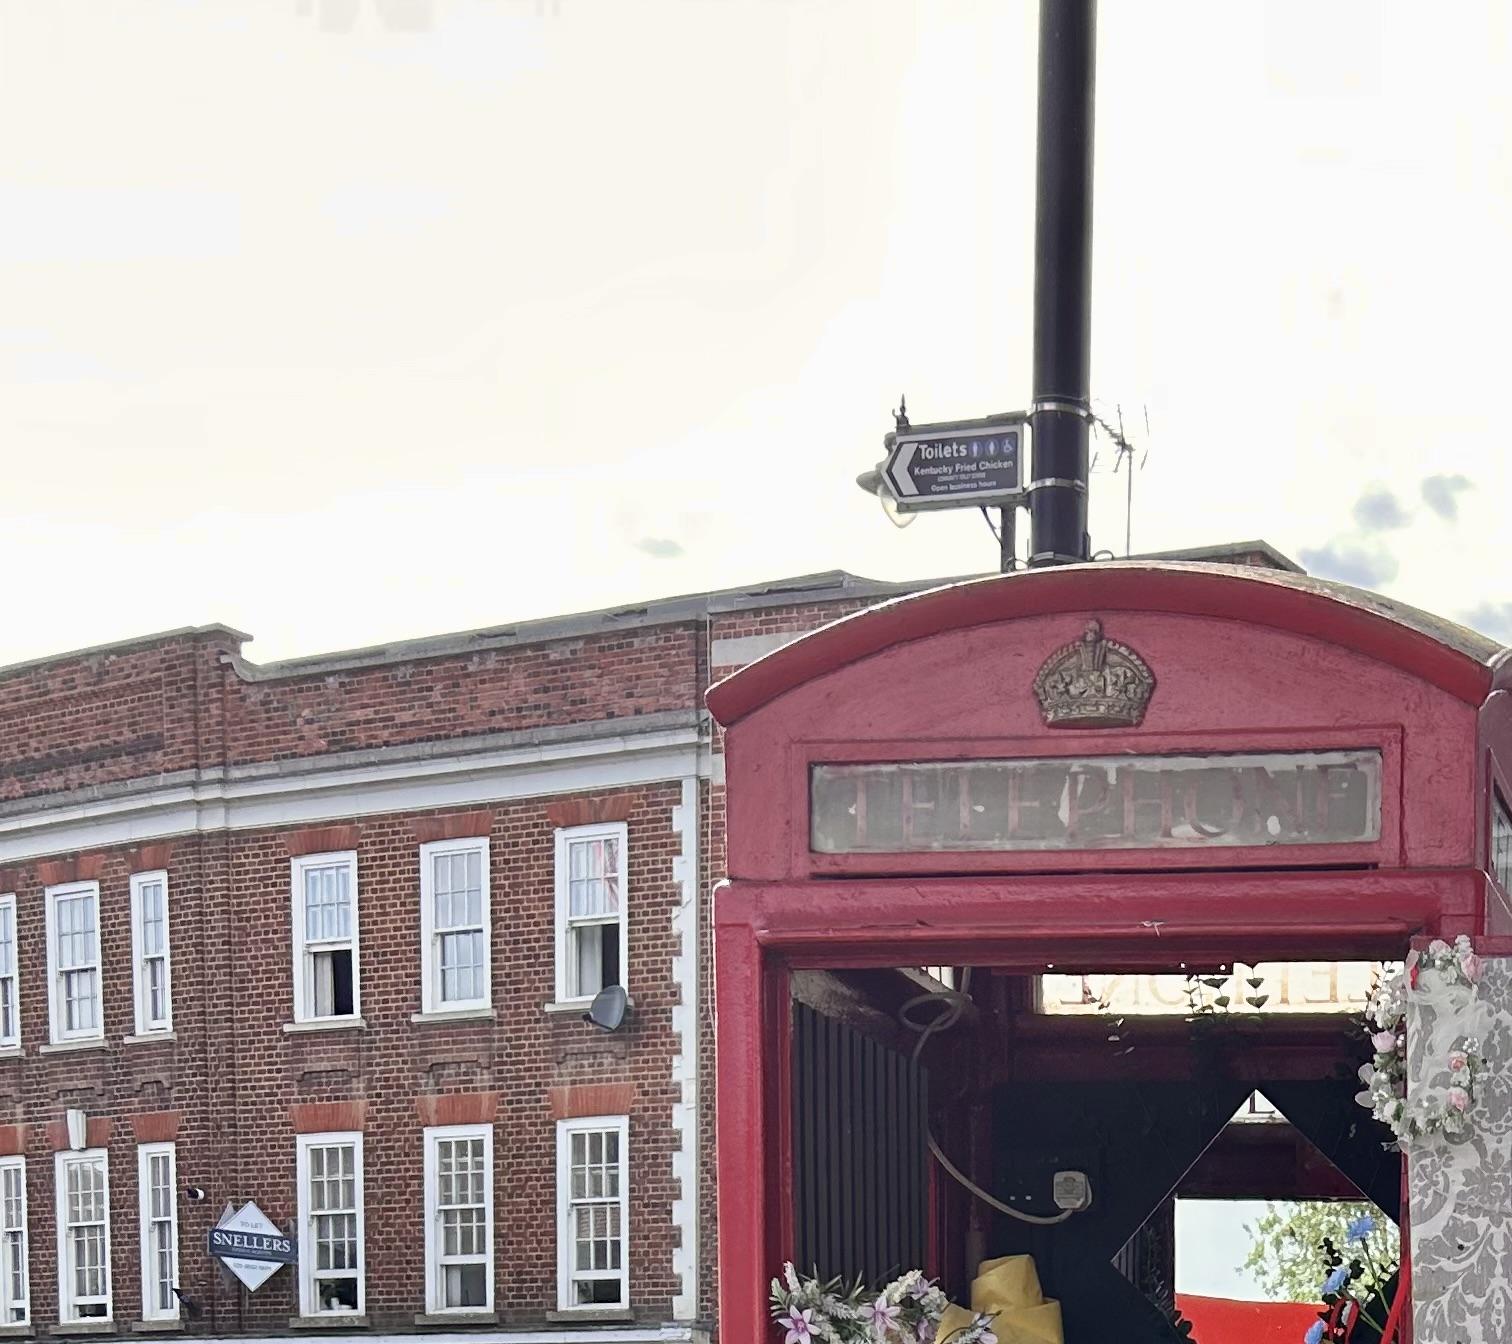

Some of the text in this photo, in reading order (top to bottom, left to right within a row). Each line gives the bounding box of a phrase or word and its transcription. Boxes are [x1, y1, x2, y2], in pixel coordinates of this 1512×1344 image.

[919, 442, 967, 459] Toilets
[914, 464, 953, 477] Kentucky
[955, 462, 977, 473] Fried
[979, 460, 1013, 471] Chicken
[931, 484, 949, 492] Open
[949, 482, 978, 491] business
[213, 1232, 291, 1253] SNELLERS
